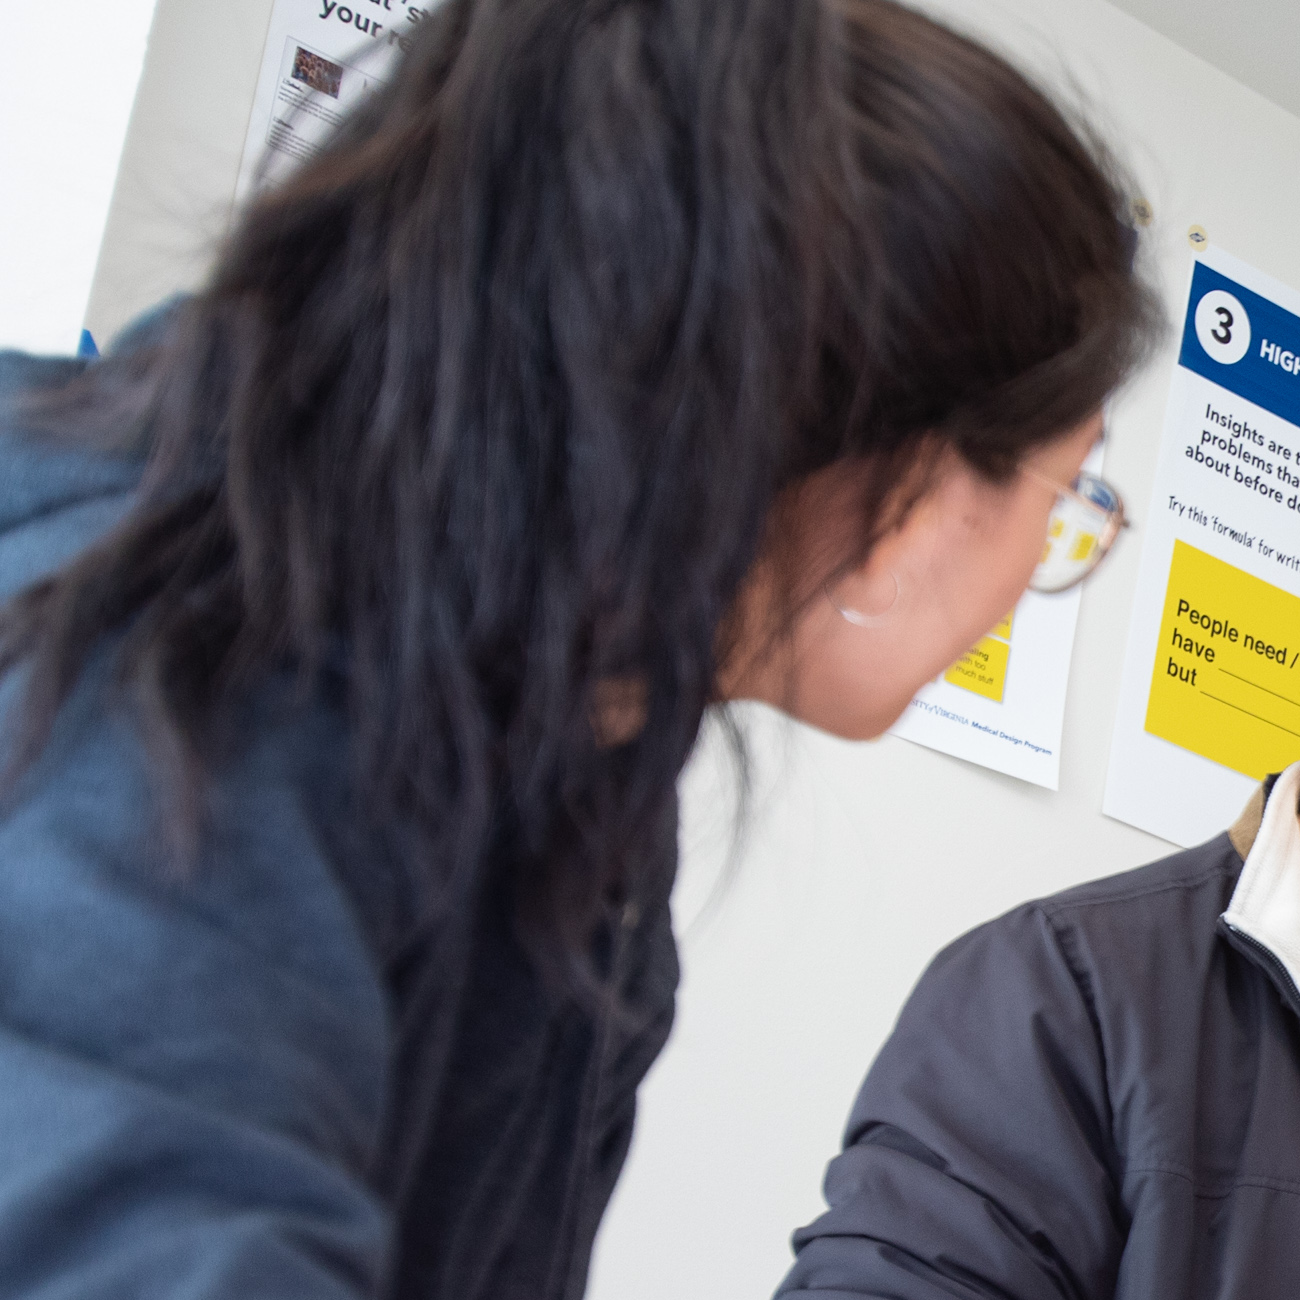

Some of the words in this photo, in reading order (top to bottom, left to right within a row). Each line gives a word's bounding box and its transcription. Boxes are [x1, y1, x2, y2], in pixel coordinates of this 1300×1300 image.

[319, 0, 382, 37] your
[1211, 306, 1234, 345] 3
[1201, 430, 1273, 474] problems
[1205, 404, 1264, 447] Insights
[1268, 441, 1292, 460] are
[1185, 445, 1231, 477] about
[1234, 466, 1283, 503] before
[1168, 496, 1186, 517] Try
[1188, 506, 1208, 526] this
[1258, 541, 1274, 559] for
[1171, 628, 1216, 663] have
[1177, 598, 1239, 643] People
[1243, 634, 1287, 665] need
[1167, 657, 1197, 686] but
[971, 721, 998, 736] Medical
[999, 731, 1022, 745] Design
[1024, 741, 1052, 756] Program
